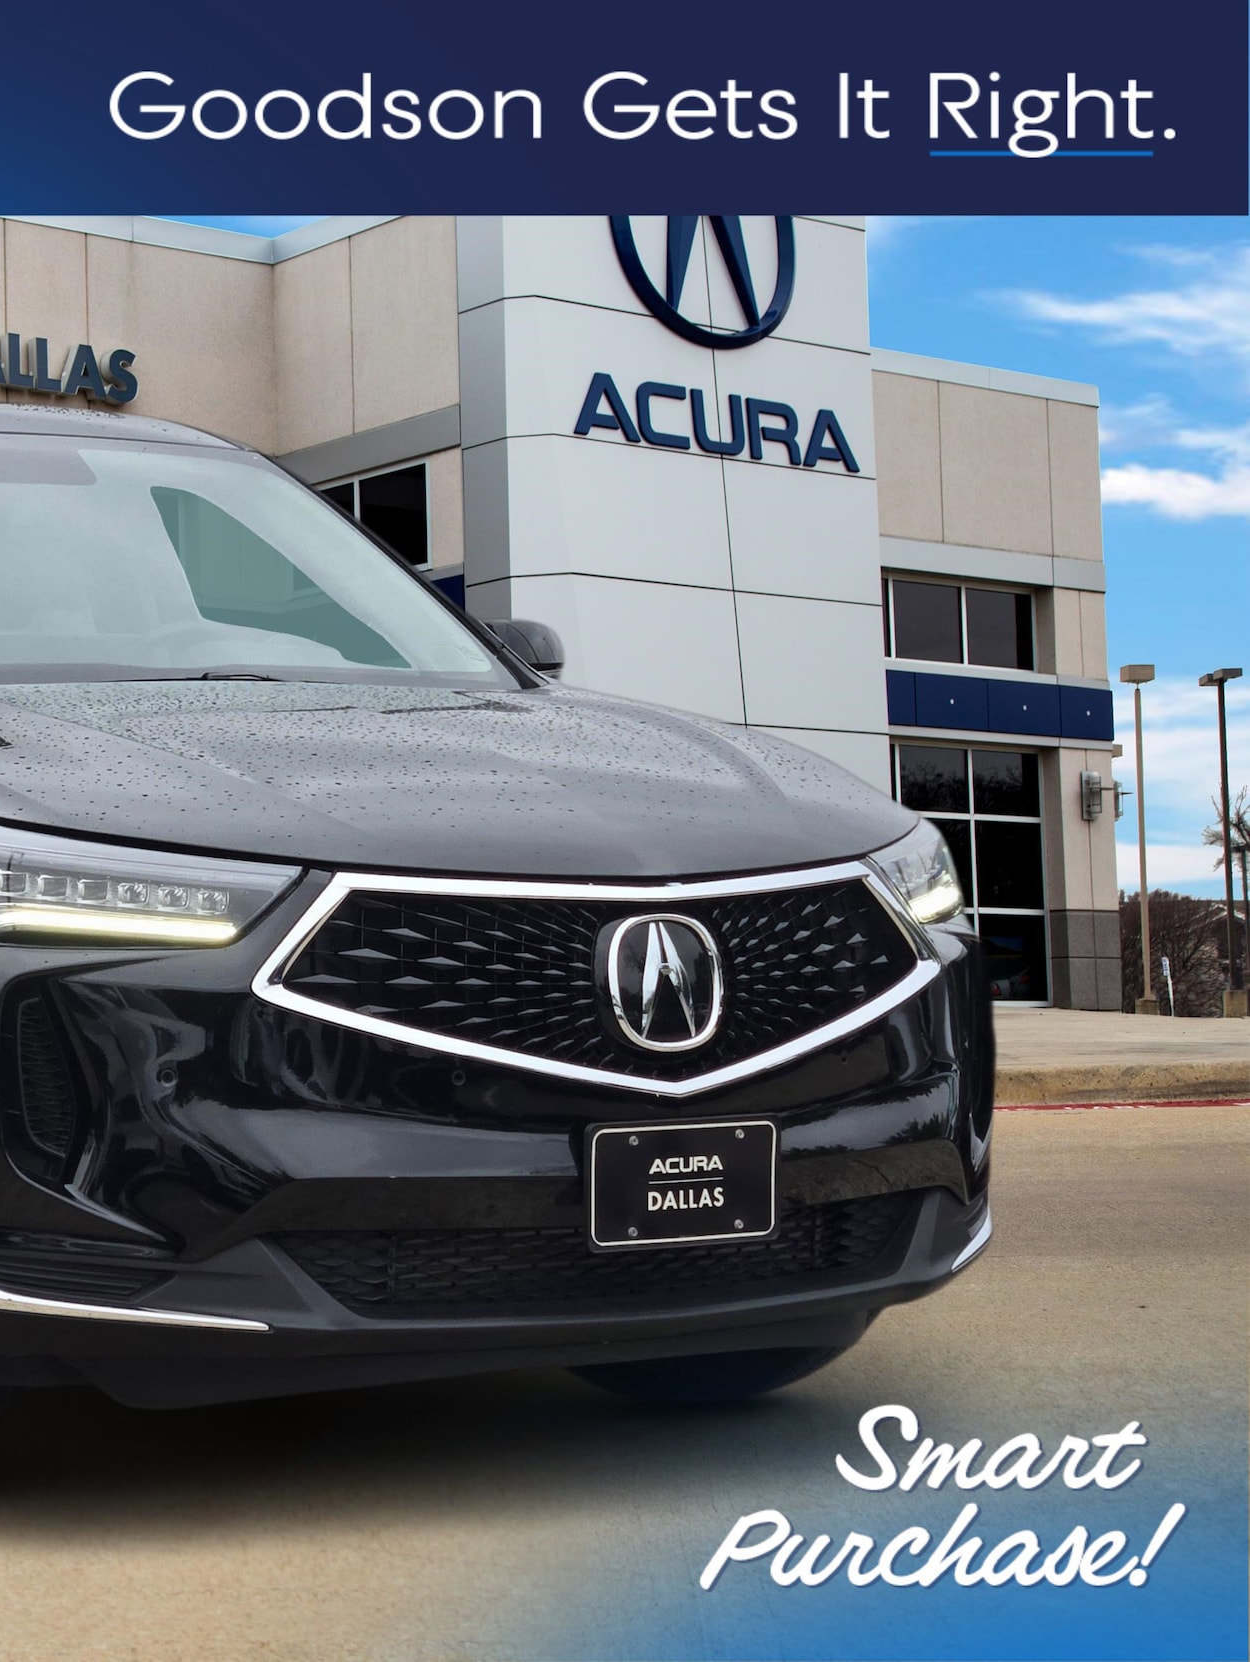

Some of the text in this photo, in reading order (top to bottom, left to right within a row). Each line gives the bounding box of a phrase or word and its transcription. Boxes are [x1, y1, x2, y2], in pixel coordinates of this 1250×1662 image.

[573, 372, 860, 473] ACURA
[648, 1155, 724, 1175] ACURA
[647, 1186, 725, 1212] DALLAS
